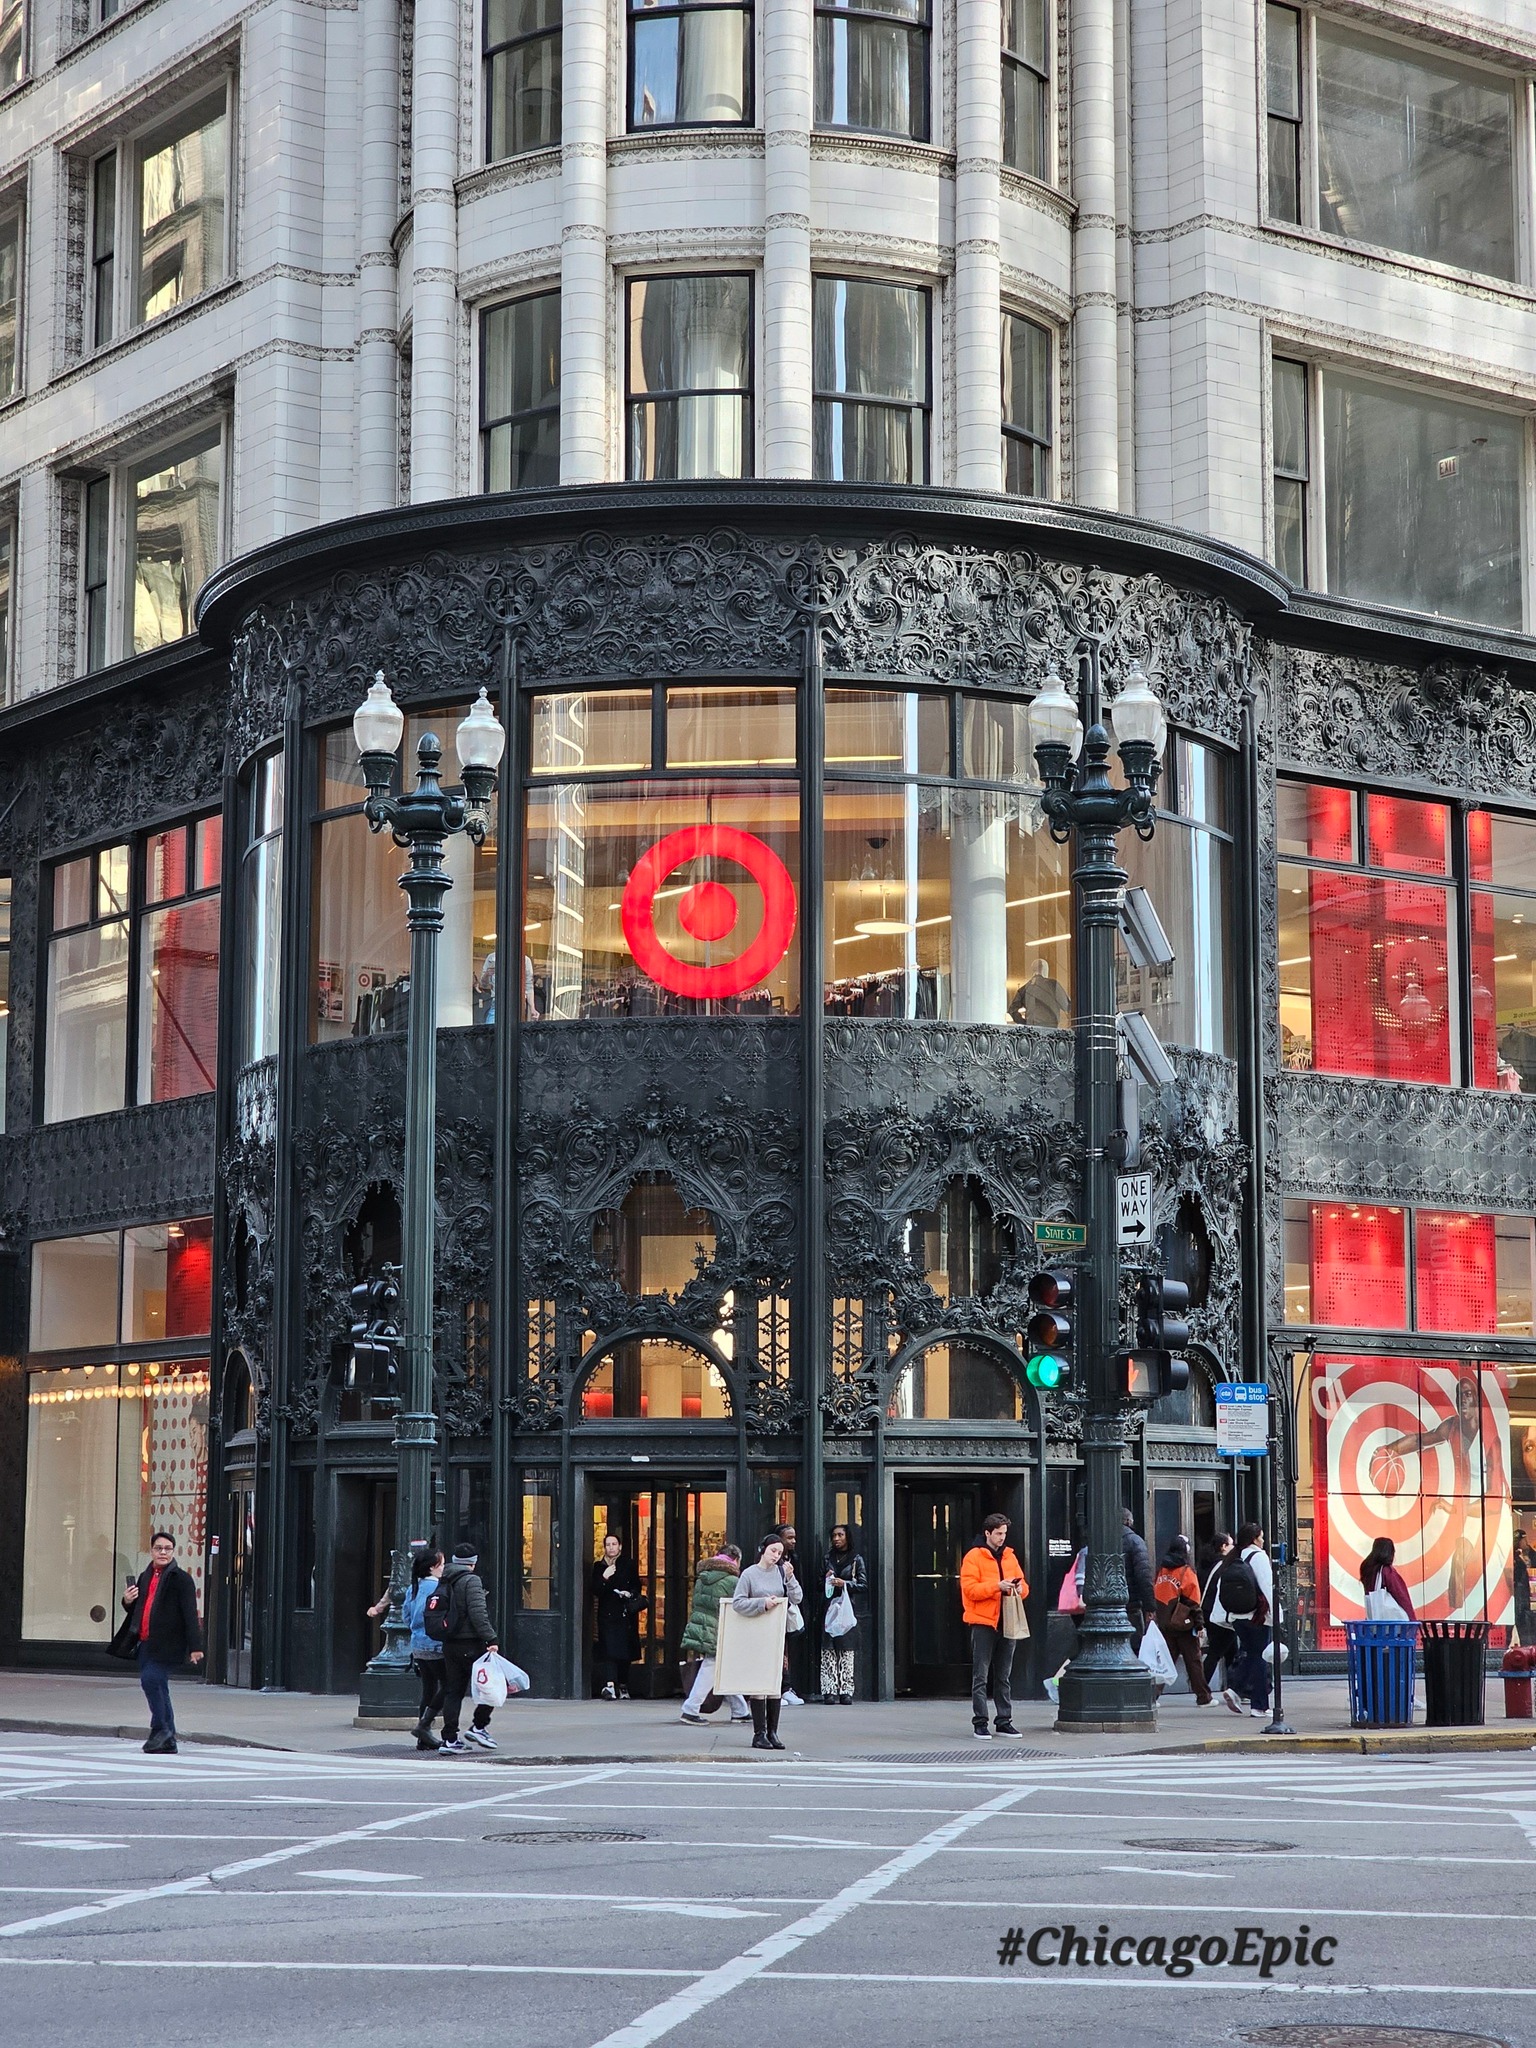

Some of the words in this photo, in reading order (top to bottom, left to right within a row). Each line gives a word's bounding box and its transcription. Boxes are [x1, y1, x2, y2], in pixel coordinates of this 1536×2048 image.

[1440, 458, 1456, 476] EXIT
[1121, 1179, 1147, 1198] ONE
[1121, 1199, 1148, 1217] WAY
[1045, 1226, 1065, 1240] STATE
[1248, 1386, 1263, 1394] bus
[1248, 1394, 1265, 1402] stop
